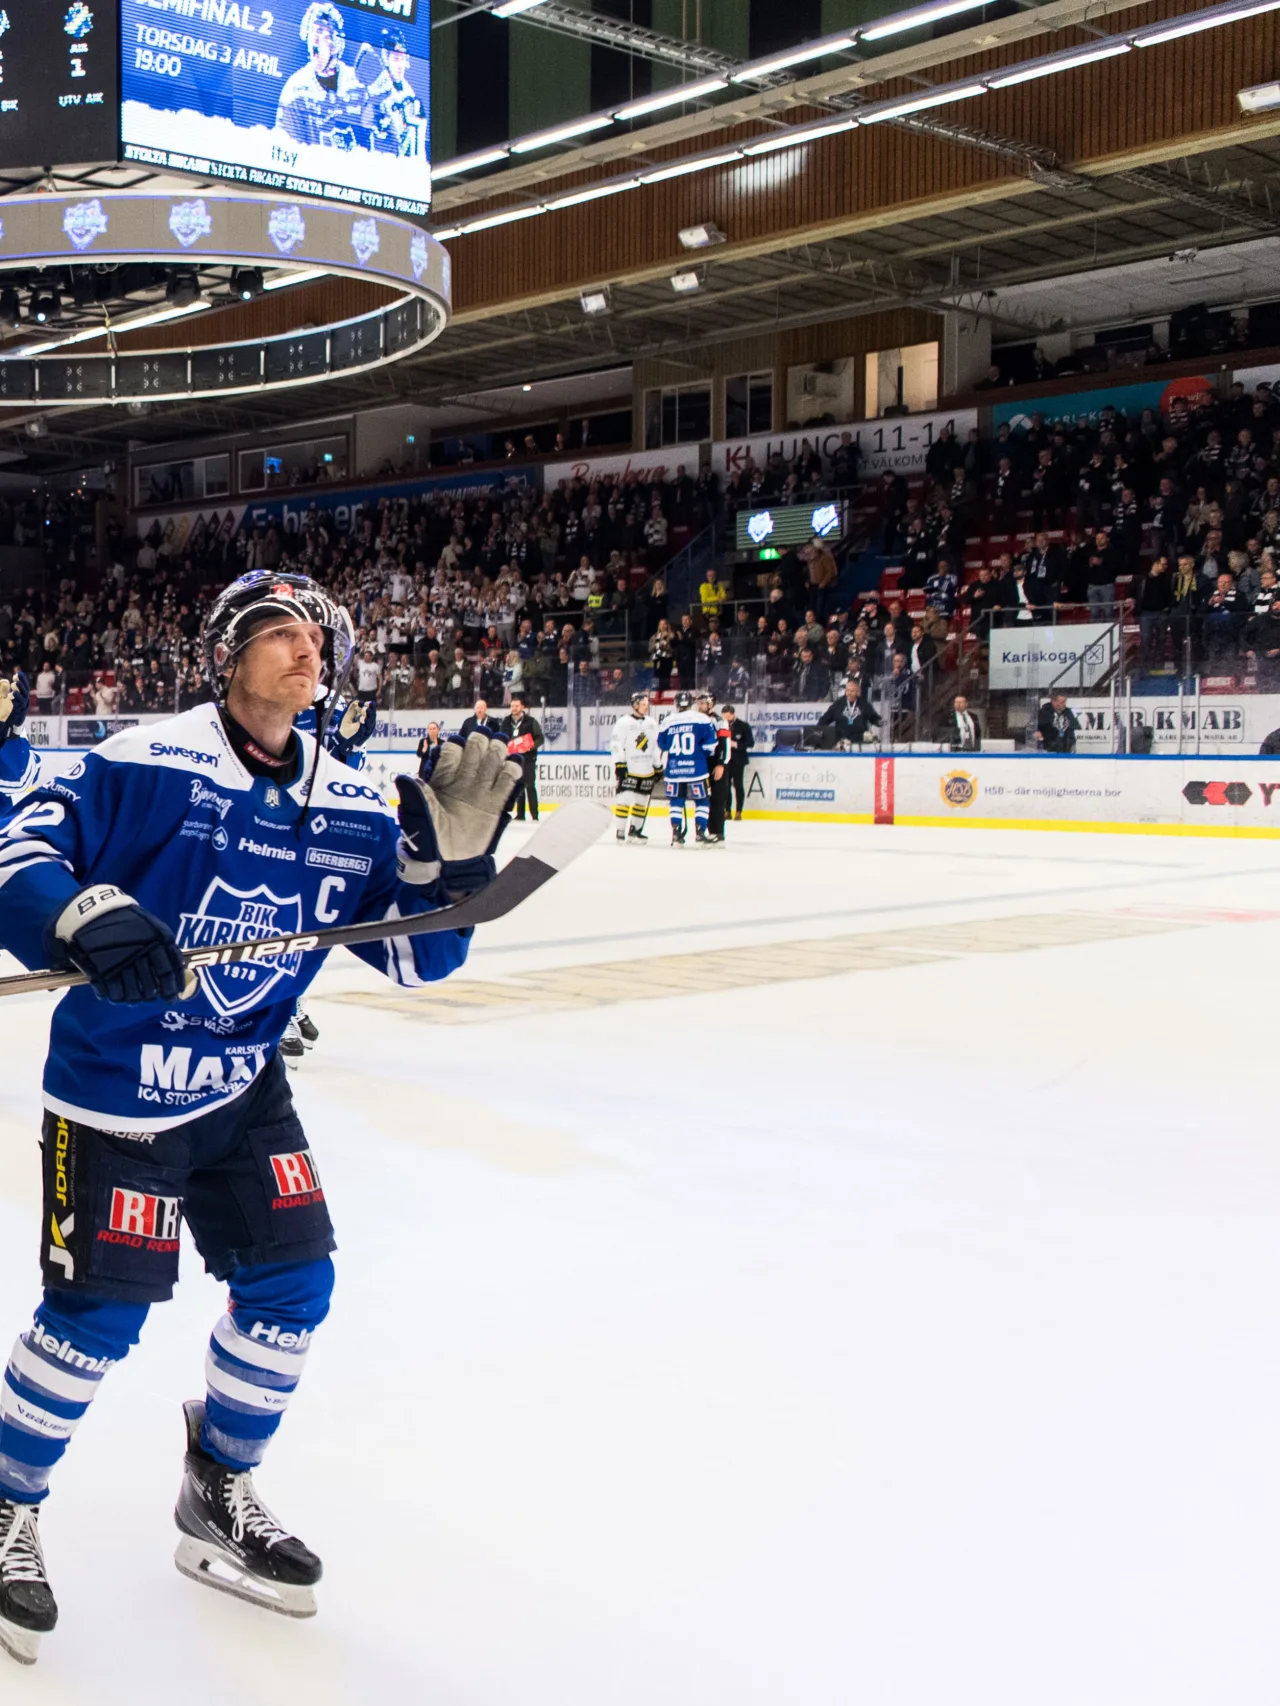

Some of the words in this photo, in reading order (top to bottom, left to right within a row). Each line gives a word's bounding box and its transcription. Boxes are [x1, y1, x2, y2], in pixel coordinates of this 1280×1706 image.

[258, 10, 274, 36] 2
[135, 23, 219, 62] TORSDAG
[220, 44, 232, 65] 3
[233, 48, 283, 79] APRIL
[70, 58, 86, 77] 1
[872, 454, 928, 471] VÄLKOM
[1002, 649, 1077, 664] Karlskoga
[669, 732, 695, 756] 40
[538, 764, 590, 782] ELCOME
[595, 764, 611, 782] TO
[775, 772, 813, 784] care
[819, 771, 836, 784] ab
[327, 780, 388, 808] coop
[540, 785, 572, 798] BOFORS
[574, 785, 595, 798] TEST
[984, 786, 1005, 797] HSB
[1014, 785, 1030, 797] där
[1032, 785, 1103, 799] möjligheterna
[1105, 787, 1122, 797] bor
[330, 819, 372, 832] KARLSKOGA
[238, 837, 296, 861] Helmia
[308, 850, 369, 873] ÖSTERBERGS
[314, 875, 346, 924] C
[241, 901, 277, 927] BIK
[223, 963, 258, 982] 1978
[137, 1085, 161, 1104] ICA
[272, 1196, 311, 1210] ROAD
[96, 1229, 144, 1248] ROAD
